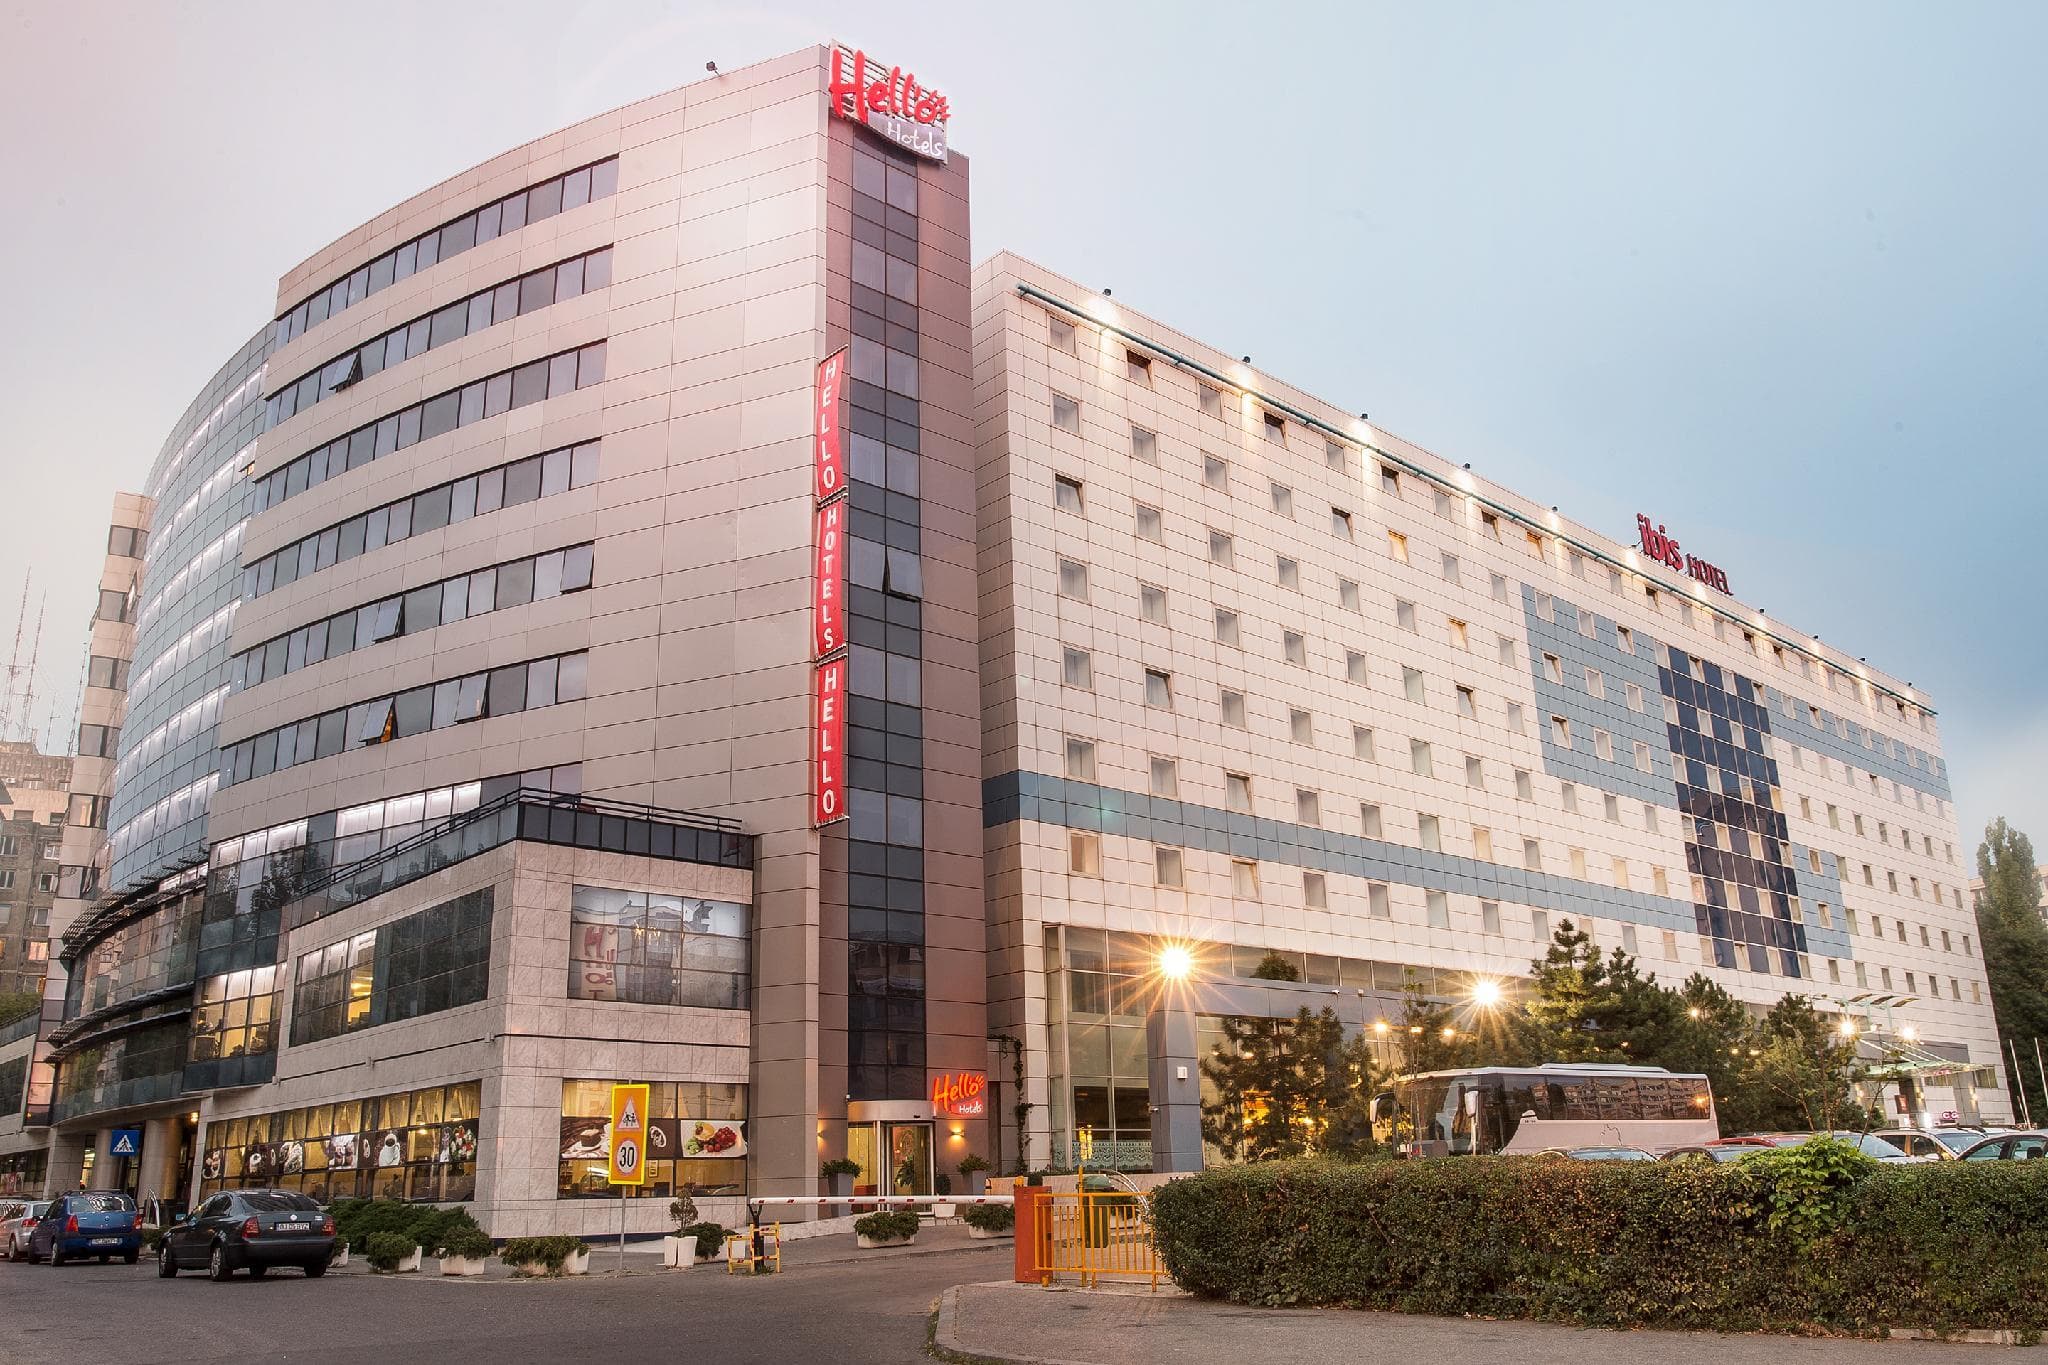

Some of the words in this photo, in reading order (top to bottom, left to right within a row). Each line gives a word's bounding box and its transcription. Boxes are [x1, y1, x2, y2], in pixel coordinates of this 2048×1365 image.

[829, 49, 938, 124] Hello
[887, 121, 943, 157] Hotels
[821, 359, 836, 489] HELLO
[1636, 512, 1684, 571] ibis
[822, 507, 837, 649] HOTELS
[822, 667, 837, 814] HELLO
[933, 1073, 979, 1112] Hello
[619, 1146, 635, 1168] 30
